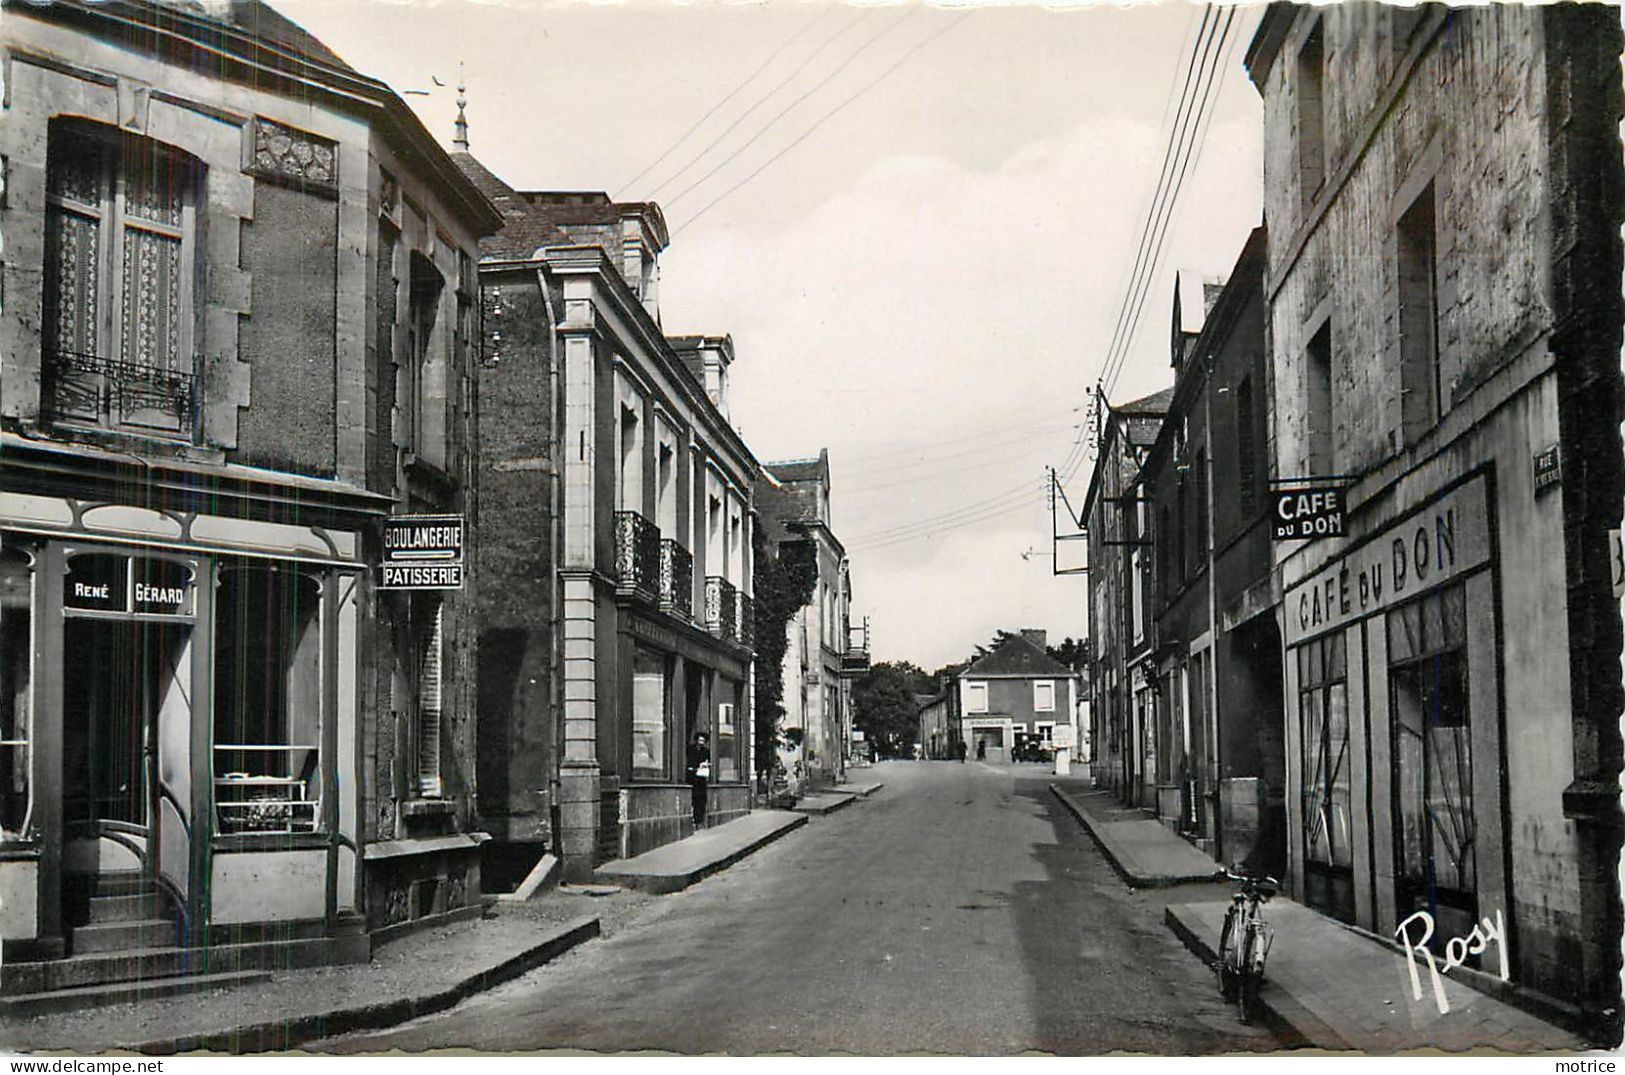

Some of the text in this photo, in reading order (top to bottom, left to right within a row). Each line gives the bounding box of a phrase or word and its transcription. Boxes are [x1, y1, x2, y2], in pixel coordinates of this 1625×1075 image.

[1277, 512, 1341, 537] DU DON
[385, 526, 461, 548] BOULANGERIE
[385, 568, 460, 585] PATISSERIE
[1300, 509, 1455, 631] CAFÉ DU DON
[135, 583, 184, 604] GÉRARD
